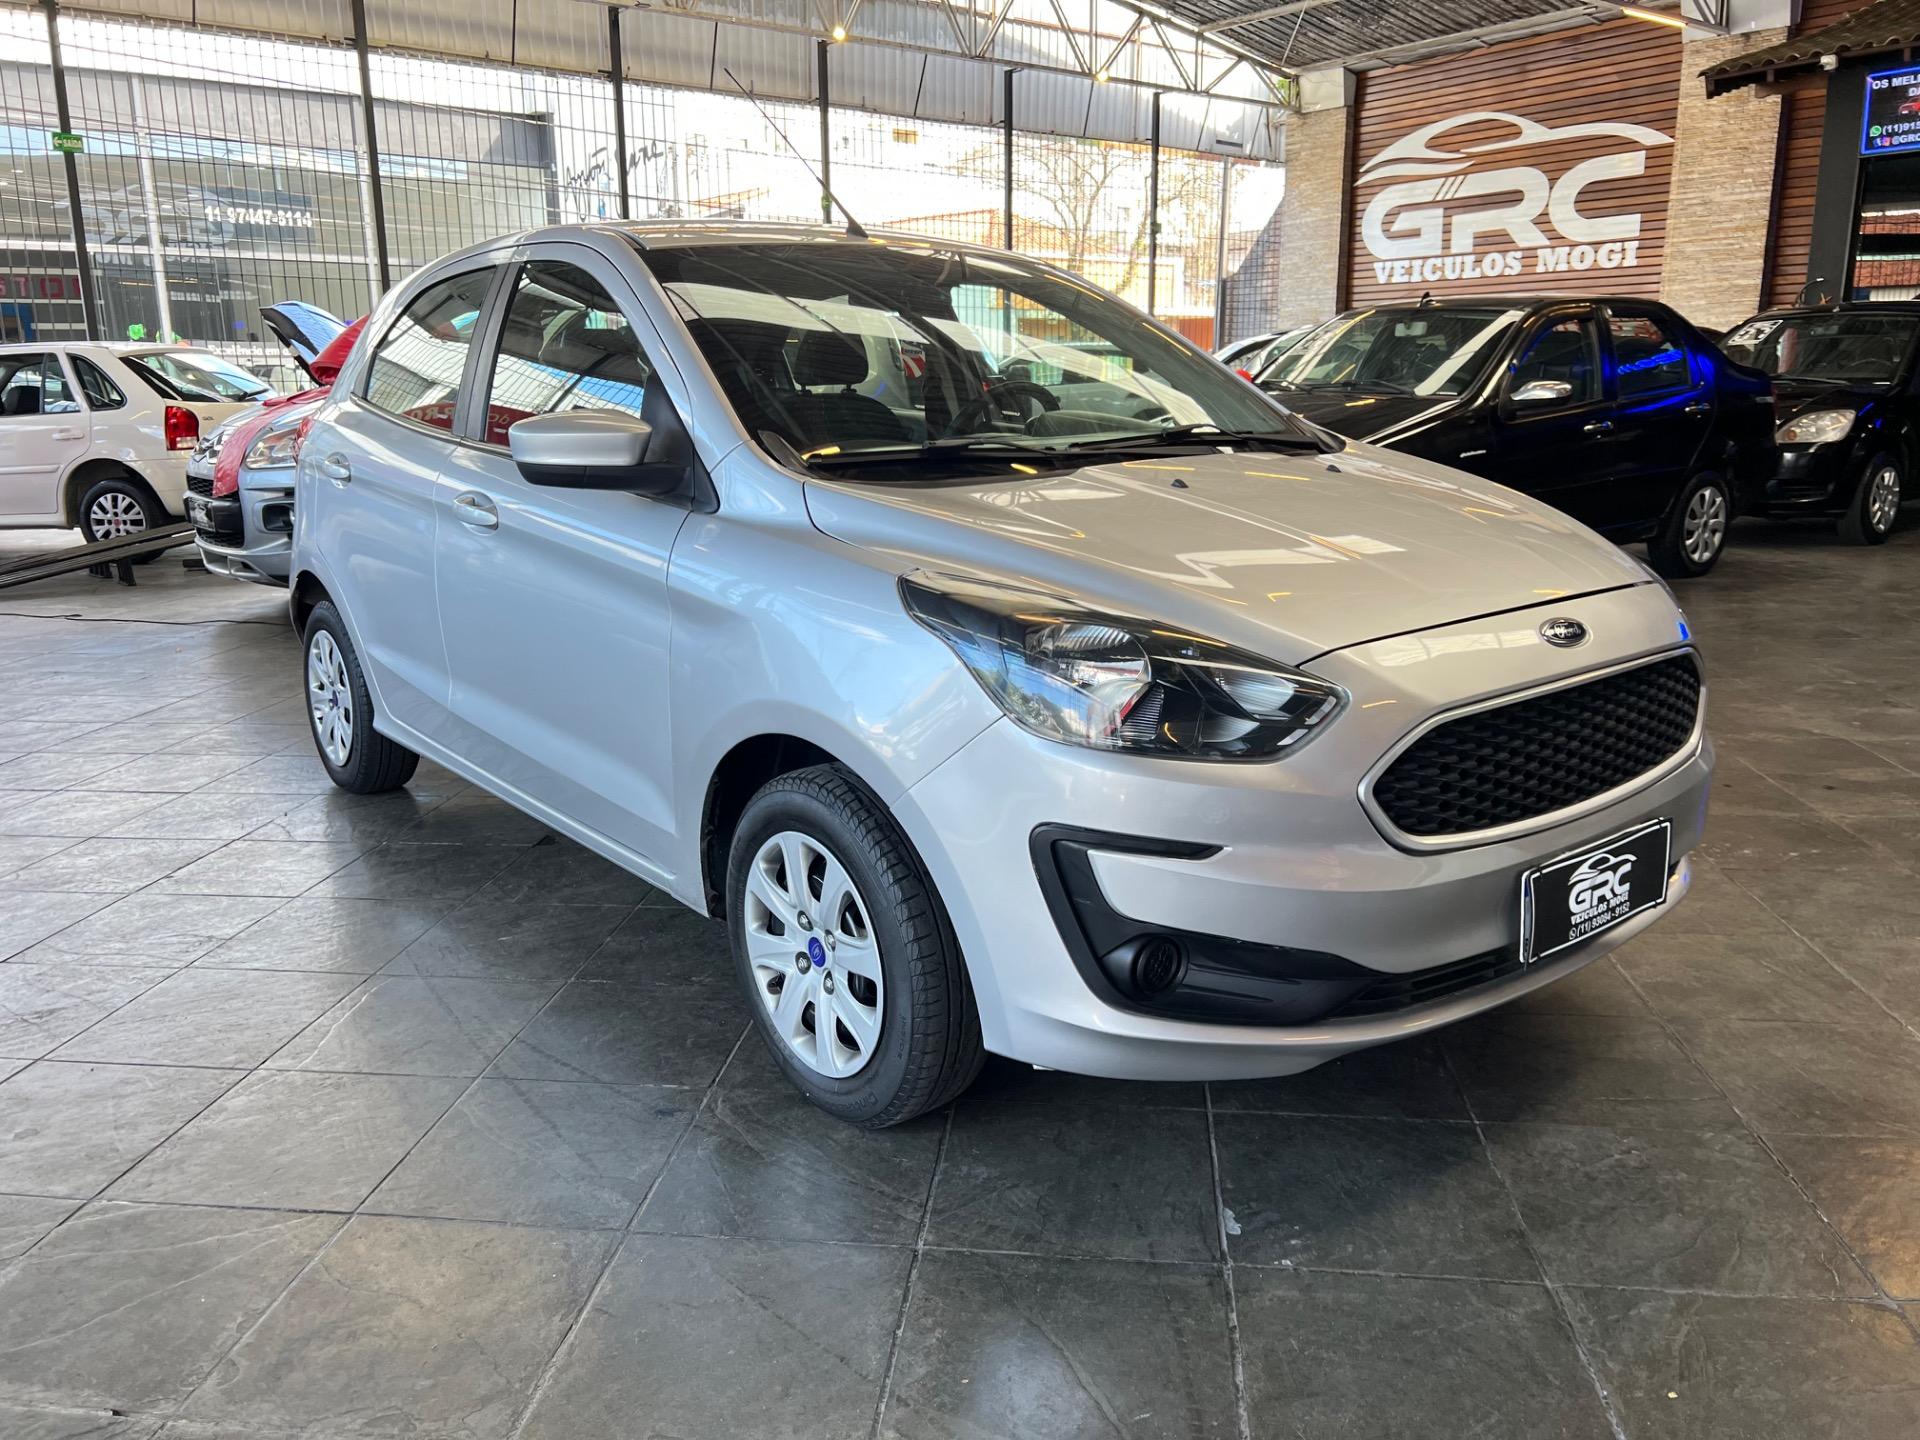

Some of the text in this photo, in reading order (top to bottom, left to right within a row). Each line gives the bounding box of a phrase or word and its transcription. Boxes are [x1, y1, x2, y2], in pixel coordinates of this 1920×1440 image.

[1872, 80, 1889, 89] OS
[205, 205, 220, 222] 11
[1362, 150, 1646, 260] GRC
[1373, 241, 1640, 284] VEICULOS MOGI
[1568, 861, 1632, 914] GRC
[1571, 891, 1629, 925] VEICULOS MOGI
